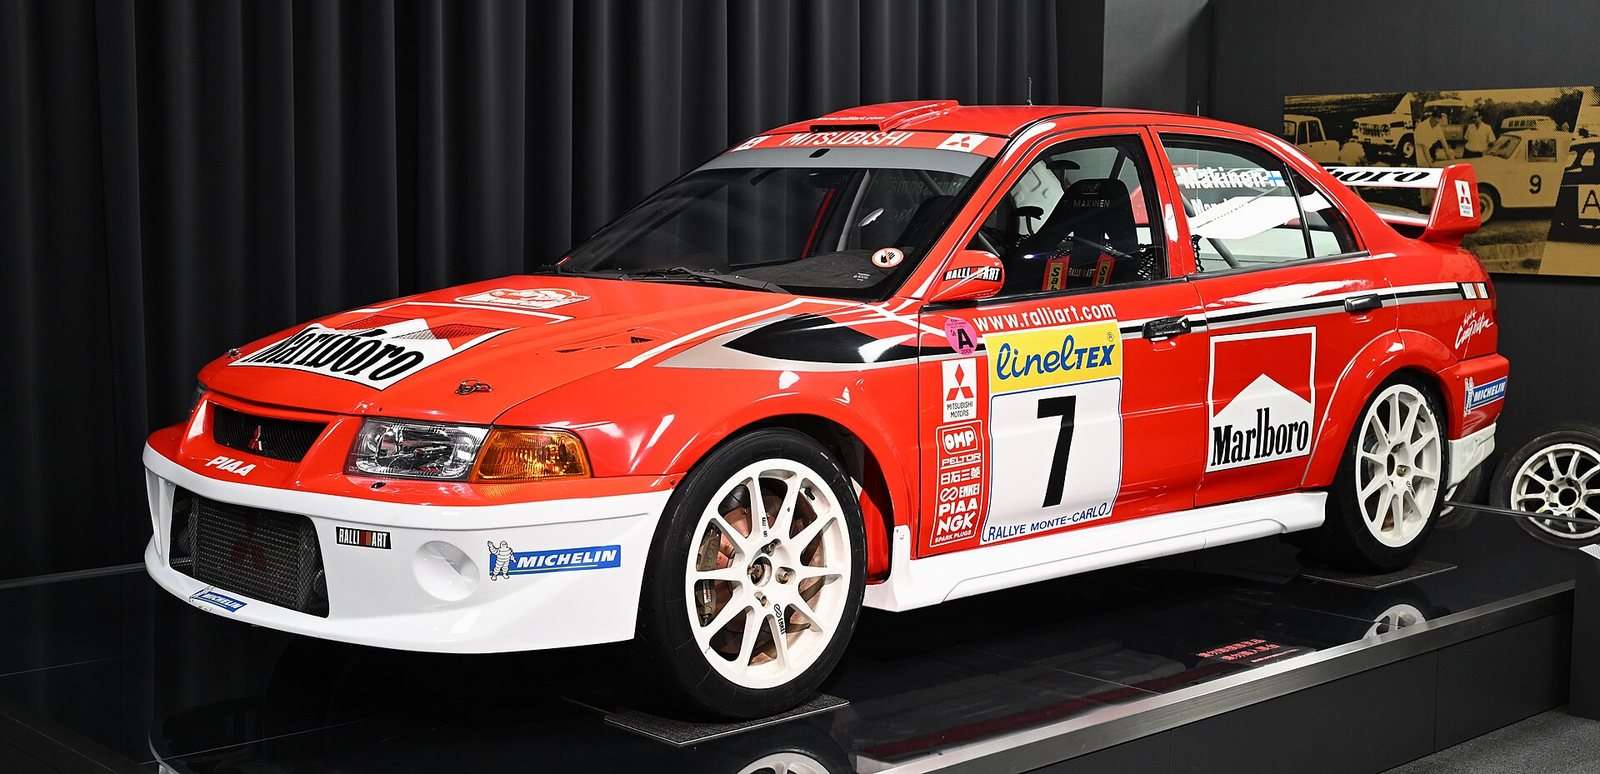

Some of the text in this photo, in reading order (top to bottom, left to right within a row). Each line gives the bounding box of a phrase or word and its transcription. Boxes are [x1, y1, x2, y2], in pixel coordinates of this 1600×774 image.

[779, 131, 915, 146] MITSUBISHI
[1528, 173, 1542, 194] 9
[1580, 189, 1600, 214] A
[973, 303, 1117, 332] www.ralliart.com
[957, 328, 975, 349] A
[1473, 381, 1506, 402] MICHELIN
[946, 401, 973, 411] MITSUBISHI
[950, 409, 969, 418] MOTORS
[944, 430, 975, 450] OMP
[1210, 407, 1309, 466] Marlboro
[942, 453, 981, 467] PELTOR
[1037, 395, 1077, 508] 7
[206, 455, 256, 477] PIAA
[938, 498, 978, 517] PIAA
[937, 511, 976, 535] NGK
[988, 502, 1108, 542] RALLYE MONTE-CARLO
[517, 549, 617, 568] MICHELIN
